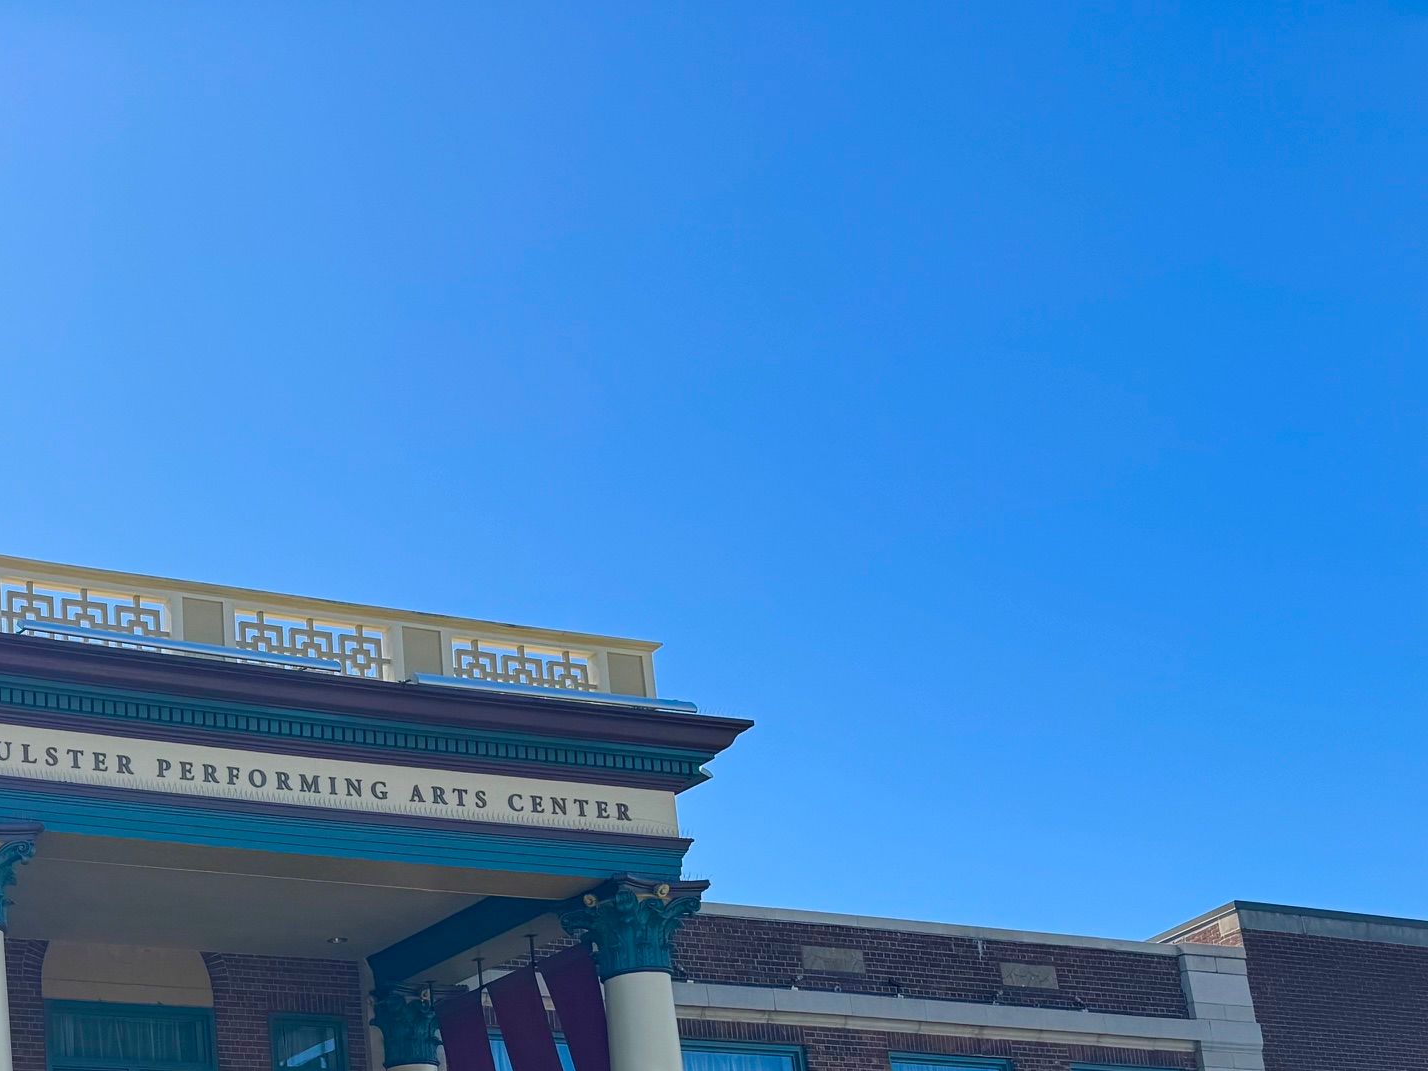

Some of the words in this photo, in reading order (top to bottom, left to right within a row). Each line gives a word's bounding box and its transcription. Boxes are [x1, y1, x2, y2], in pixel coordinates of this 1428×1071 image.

[156, 758, 389, 800] PERFORMING
[409, 784, 488, 809] ARTS
[507, 793, 633, 822] CENTER
